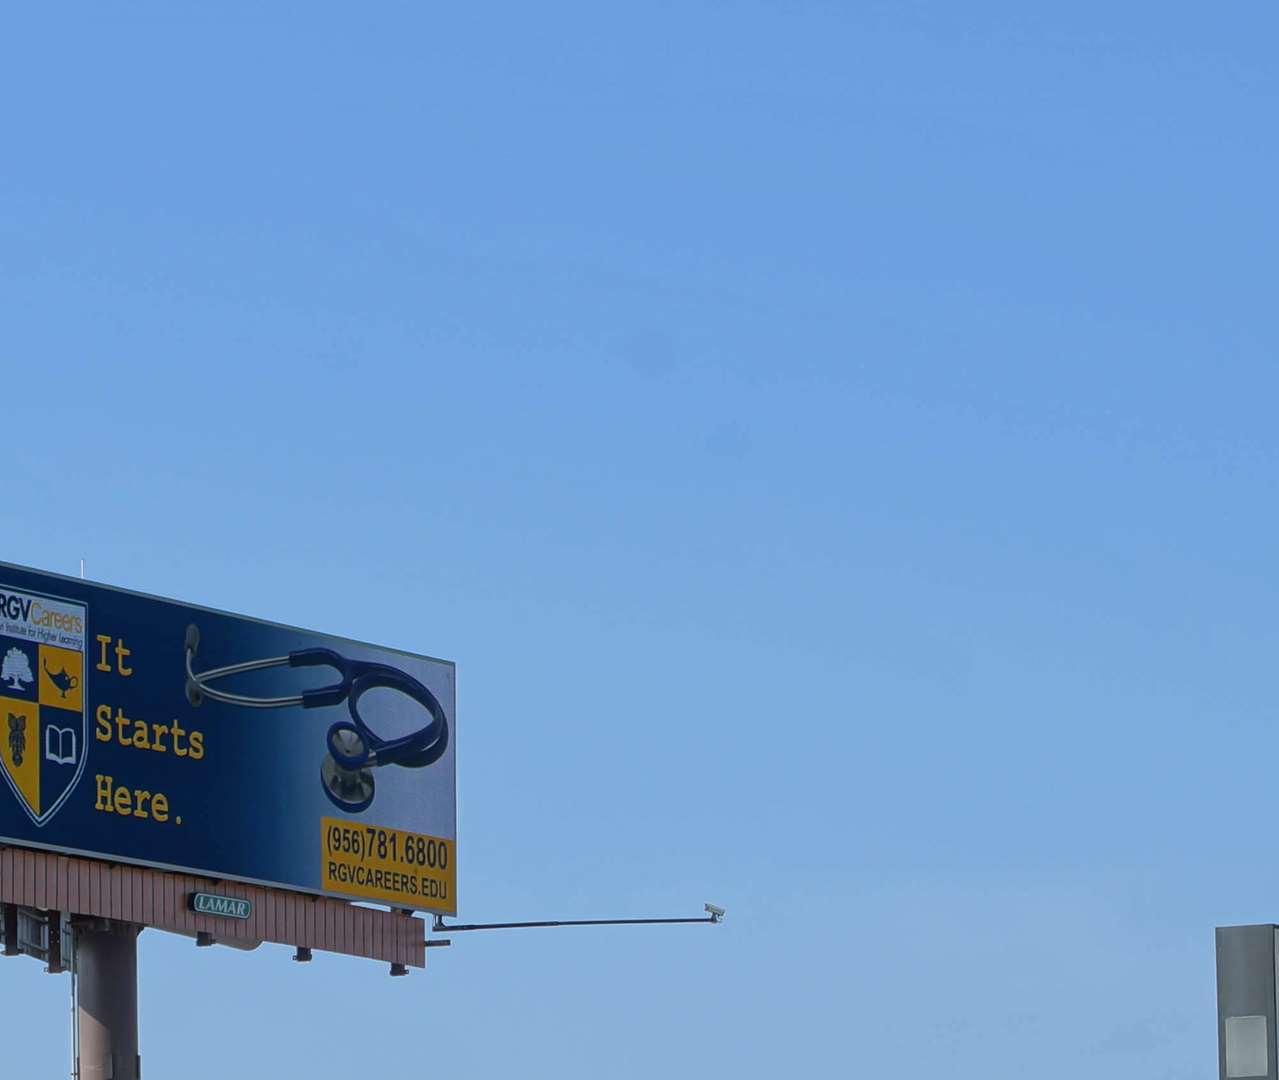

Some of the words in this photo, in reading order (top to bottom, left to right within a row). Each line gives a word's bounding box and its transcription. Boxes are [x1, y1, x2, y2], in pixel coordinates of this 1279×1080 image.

[96, 634, 132, 676] It
[95, 704, 205, 760] Starts
[95, 774, 182, 825] Here.
[327, 825, 448, 870] (956)781.6800
[328, 861, 448, 899] RGVCAREERS.EDU
[198, 896, 245, 916] LAMAR
